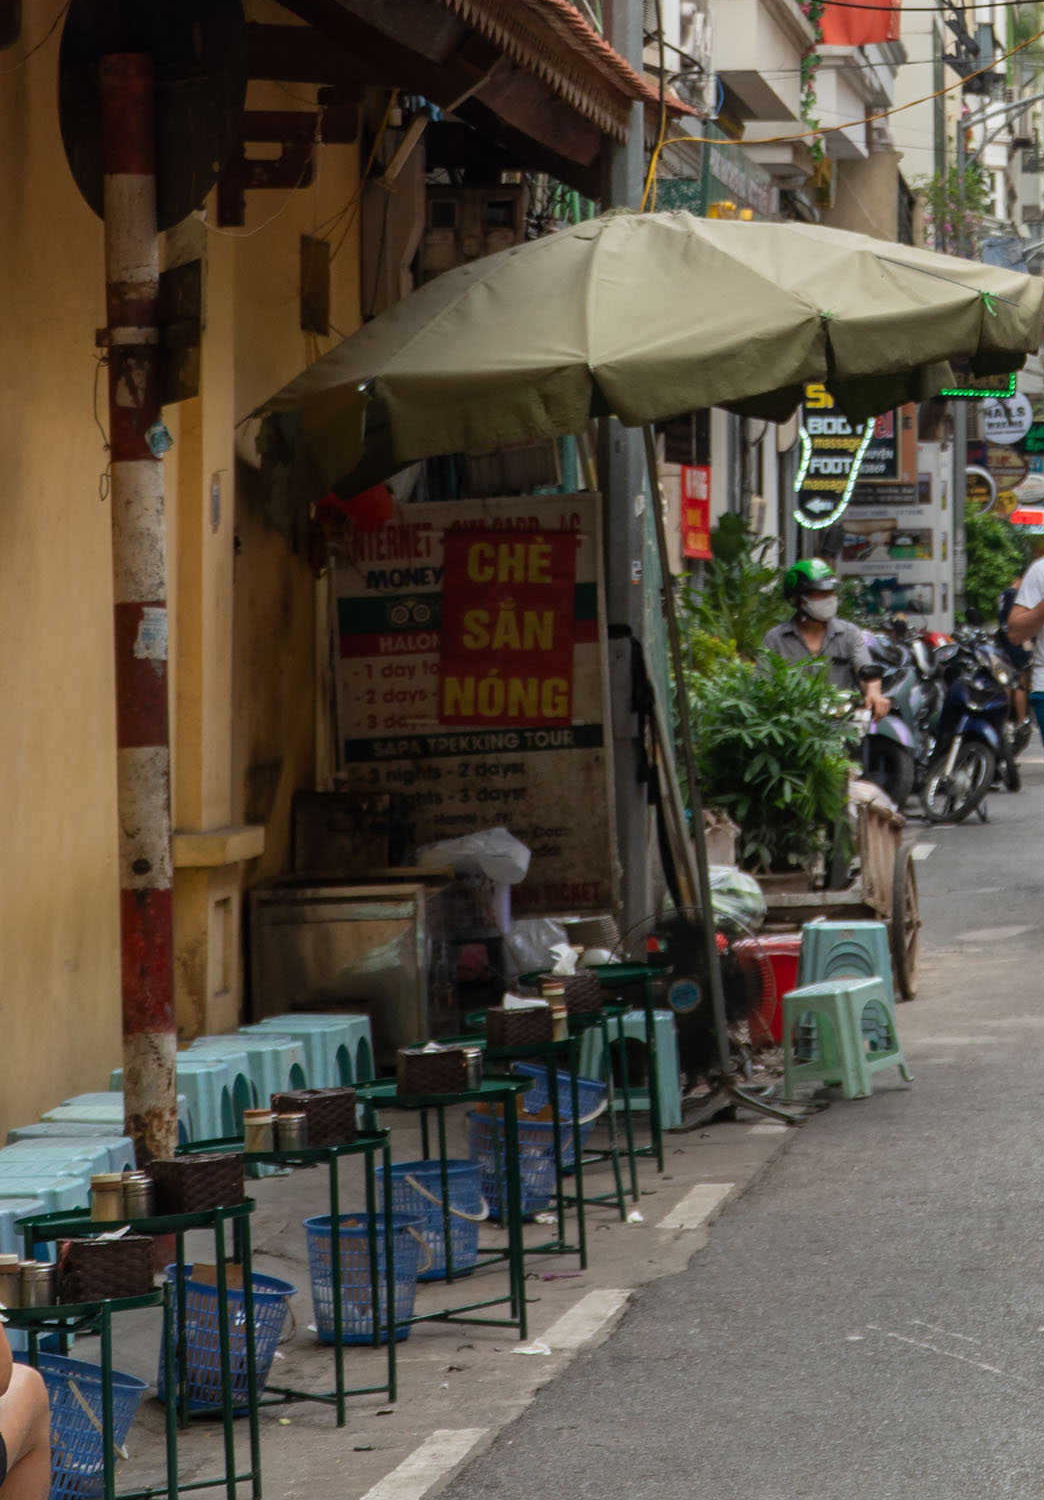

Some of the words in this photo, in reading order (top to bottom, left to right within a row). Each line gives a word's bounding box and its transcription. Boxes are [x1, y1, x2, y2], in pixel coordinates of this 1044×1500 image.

[810, 457, 853, 474] FOOT
[353, 522, 432, 562] NTERNET
[467, 537, 553, 583] CHÈ
[461, 597, 555, 650] SẮN
[381, 661, 417, 680] day
[365, 689, 377, 705] 2
[382, 686, 428, 706] days
[443, 668, 568, 717] NÓNG
[373, 740, 421, 757] SAPA
[524, 729, 575, 747] TOUR
[457, 763, 471, 778] 2
